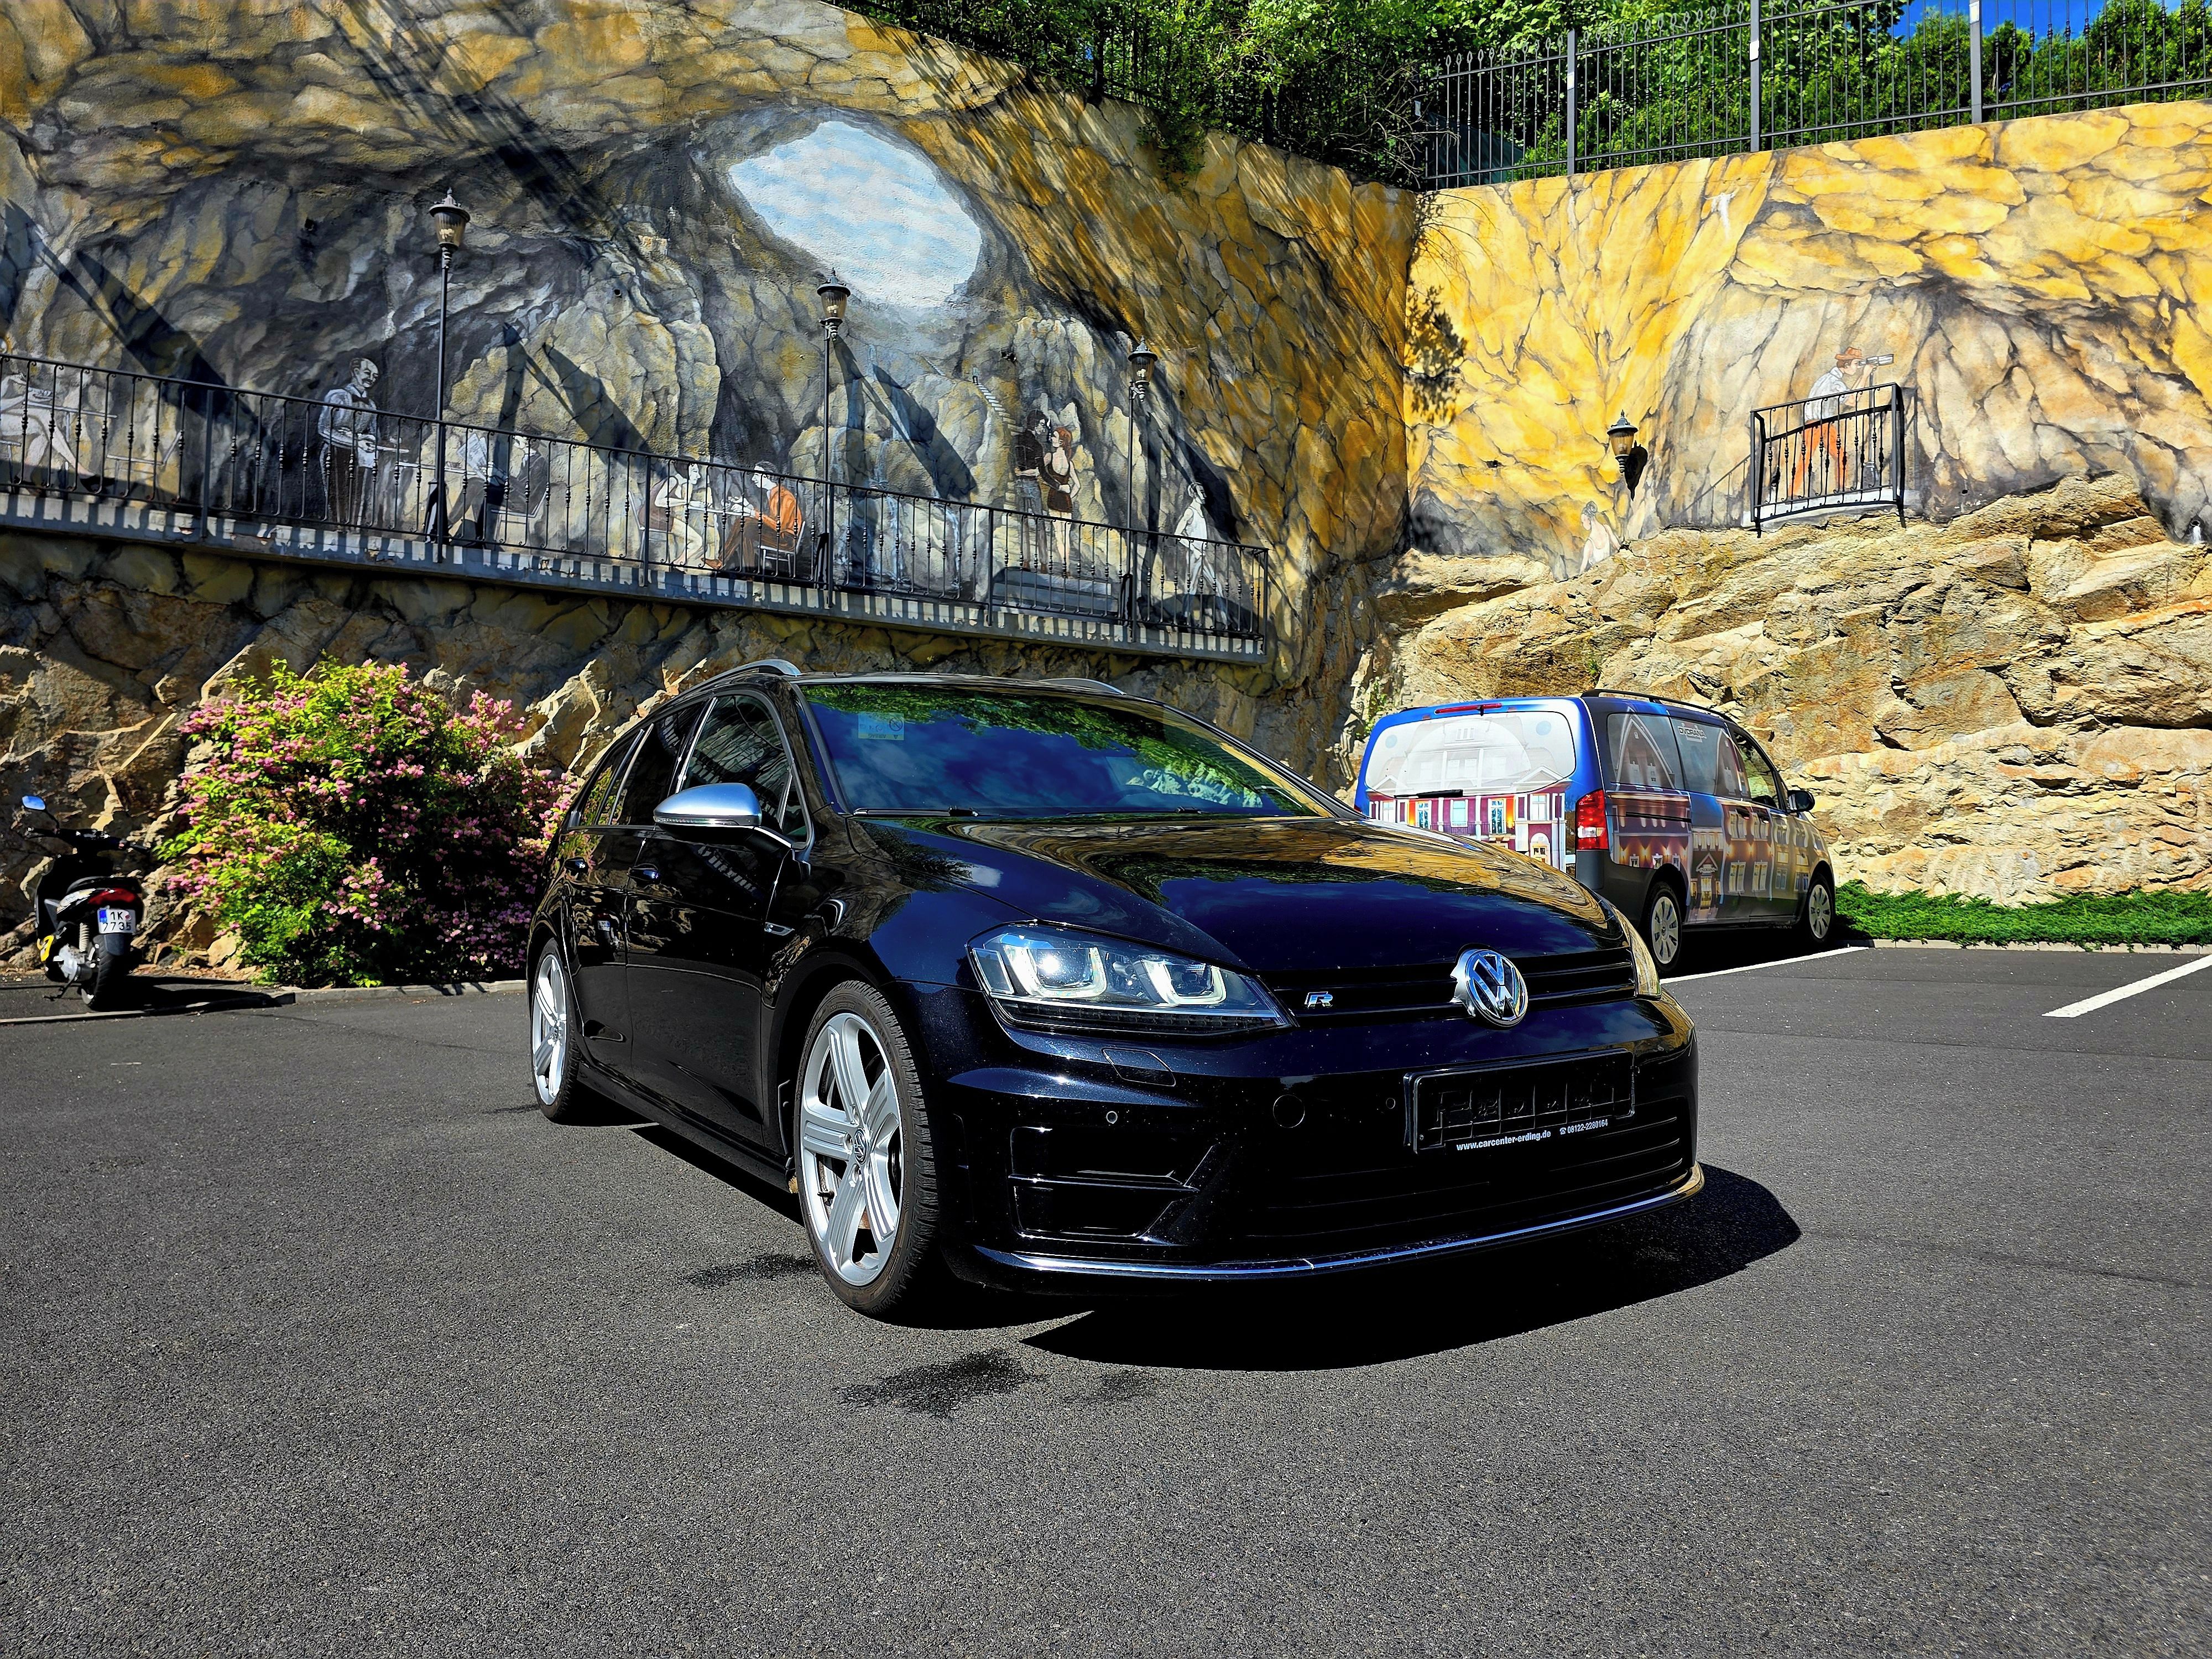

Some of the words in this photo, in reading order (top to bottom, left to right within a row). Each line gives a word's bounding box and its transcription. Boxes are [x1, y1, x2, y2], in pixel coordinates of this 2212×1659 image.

[111, 911, 123, 920] 1K
[103, 922, 132, 931] 7735
[1457, 1130, 1551, 1151] www.carcenter-erding.de
[1567, 1119, 1608, 1134] 08122-2280164
